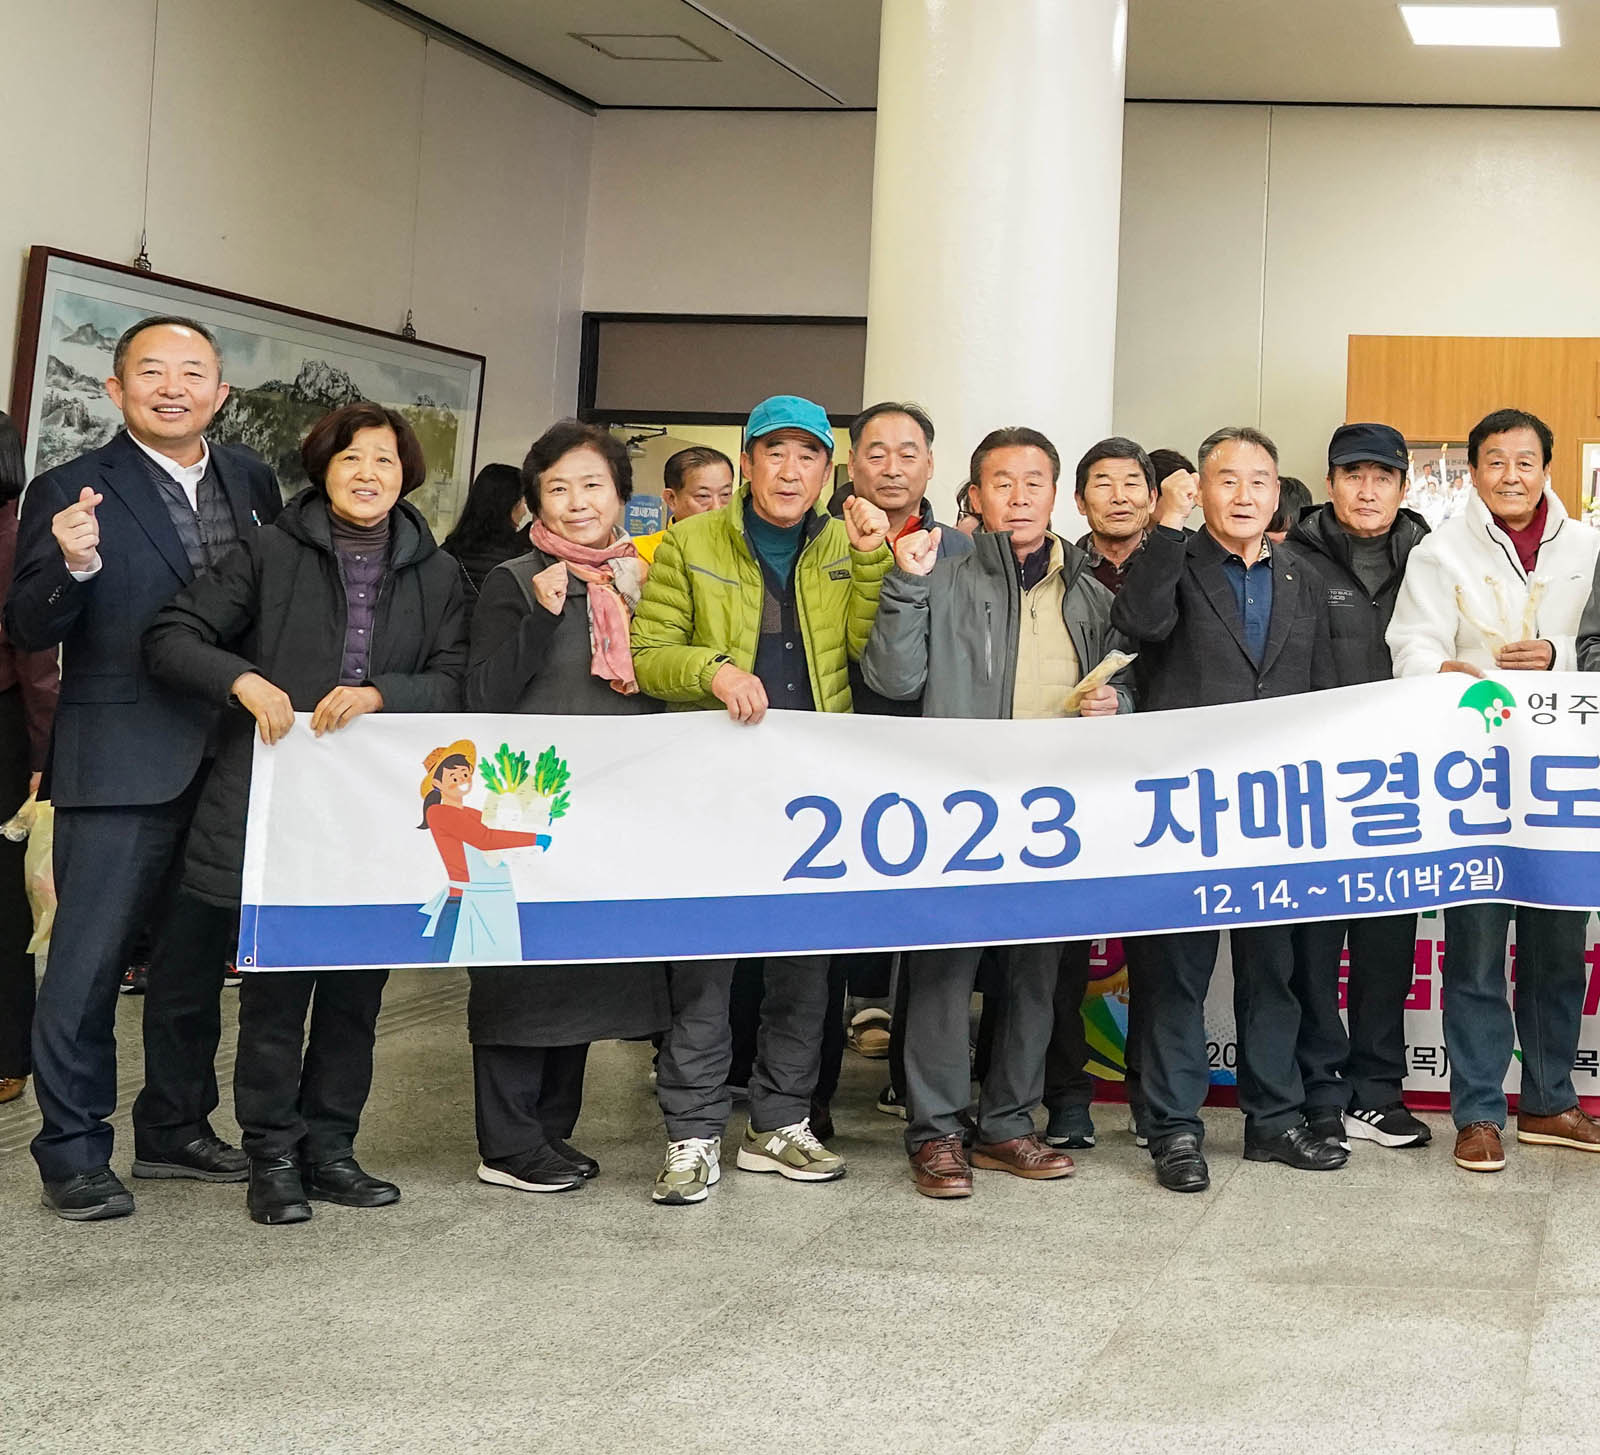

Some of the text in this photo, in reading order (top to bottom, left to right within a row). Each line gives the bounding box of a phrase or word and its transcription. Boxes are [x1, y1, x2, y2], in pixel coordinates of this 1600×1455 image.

[783, 786, 1081, 881] 2023
[1193, 884, 1241, 915] 12.
[1251, 879, 1299, 910] 14.
